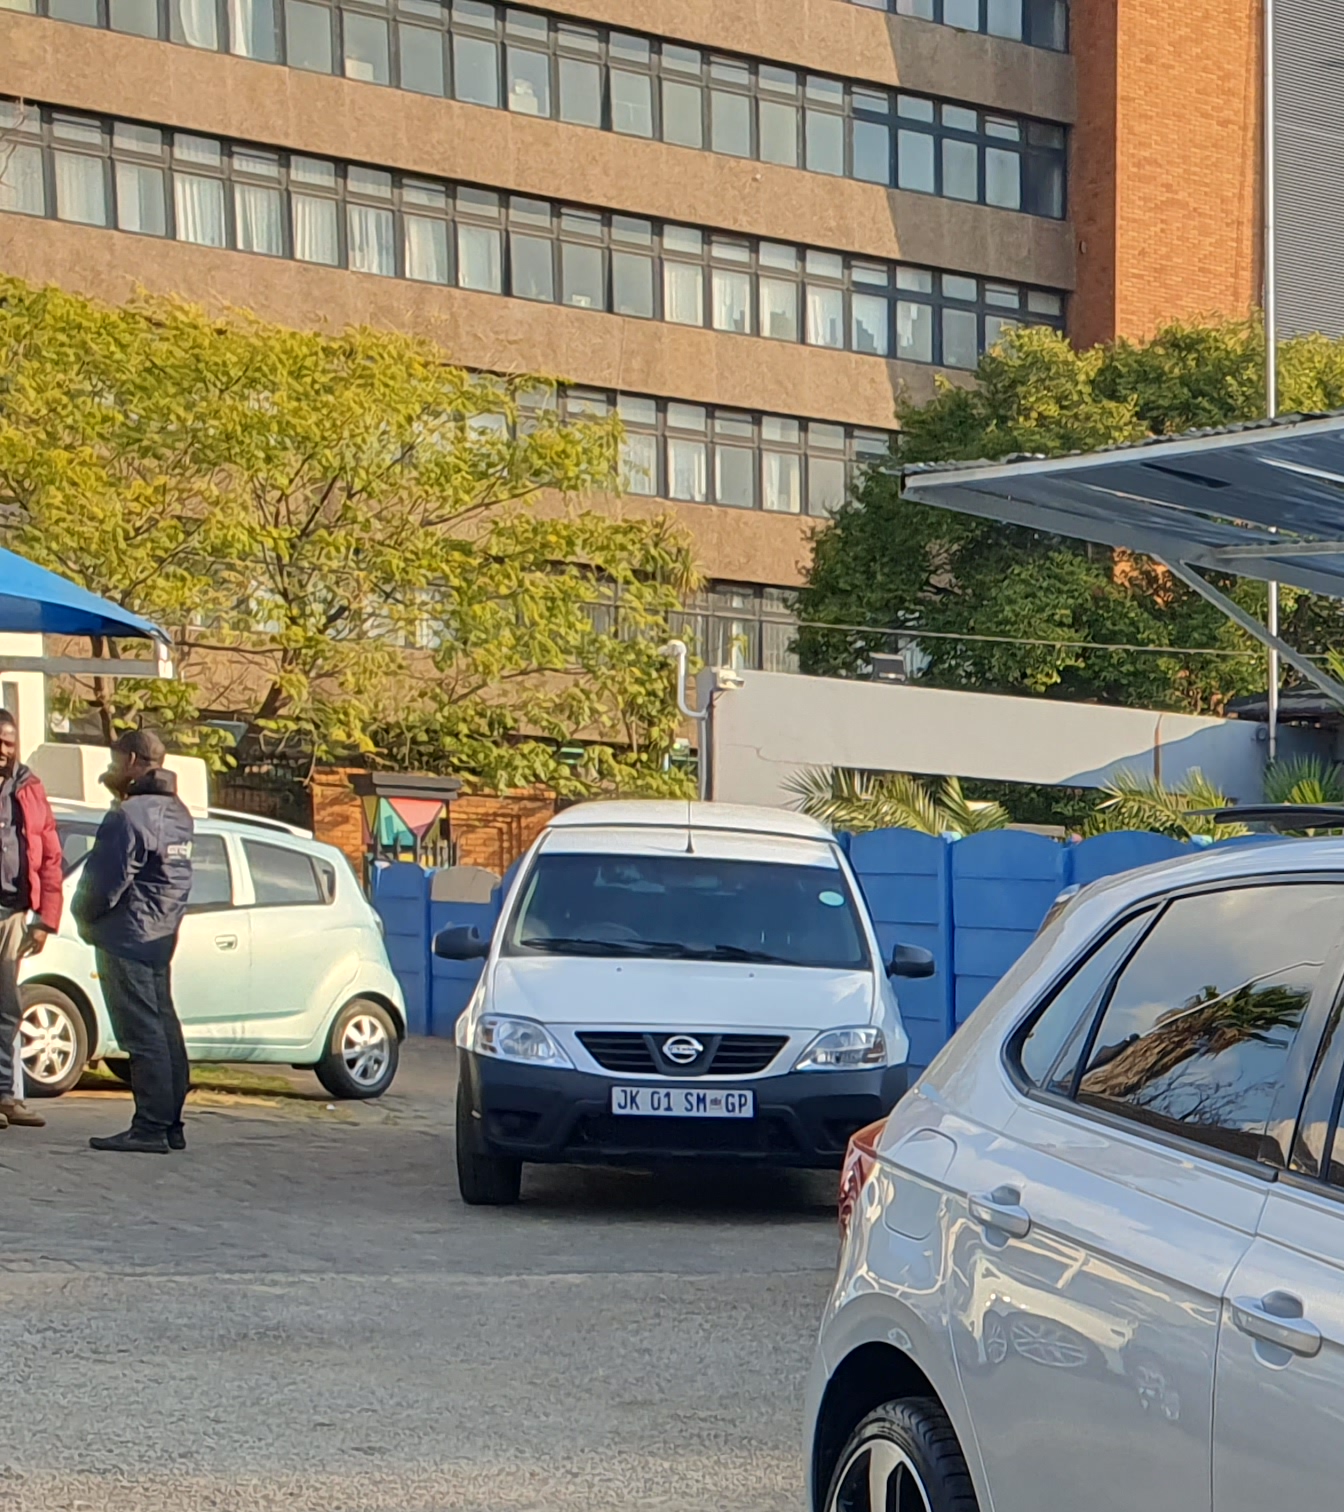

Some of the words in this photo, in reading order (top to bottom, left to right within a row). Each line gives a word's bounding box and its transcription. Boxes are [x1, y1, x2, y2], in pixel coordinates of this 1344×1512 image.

[617, 1089, 640, 1111] JK
[650, 1091, 673, 1112] 01
[684, 1092, 707, 1113] SM
[725, 1093, 748, 1114] GP
